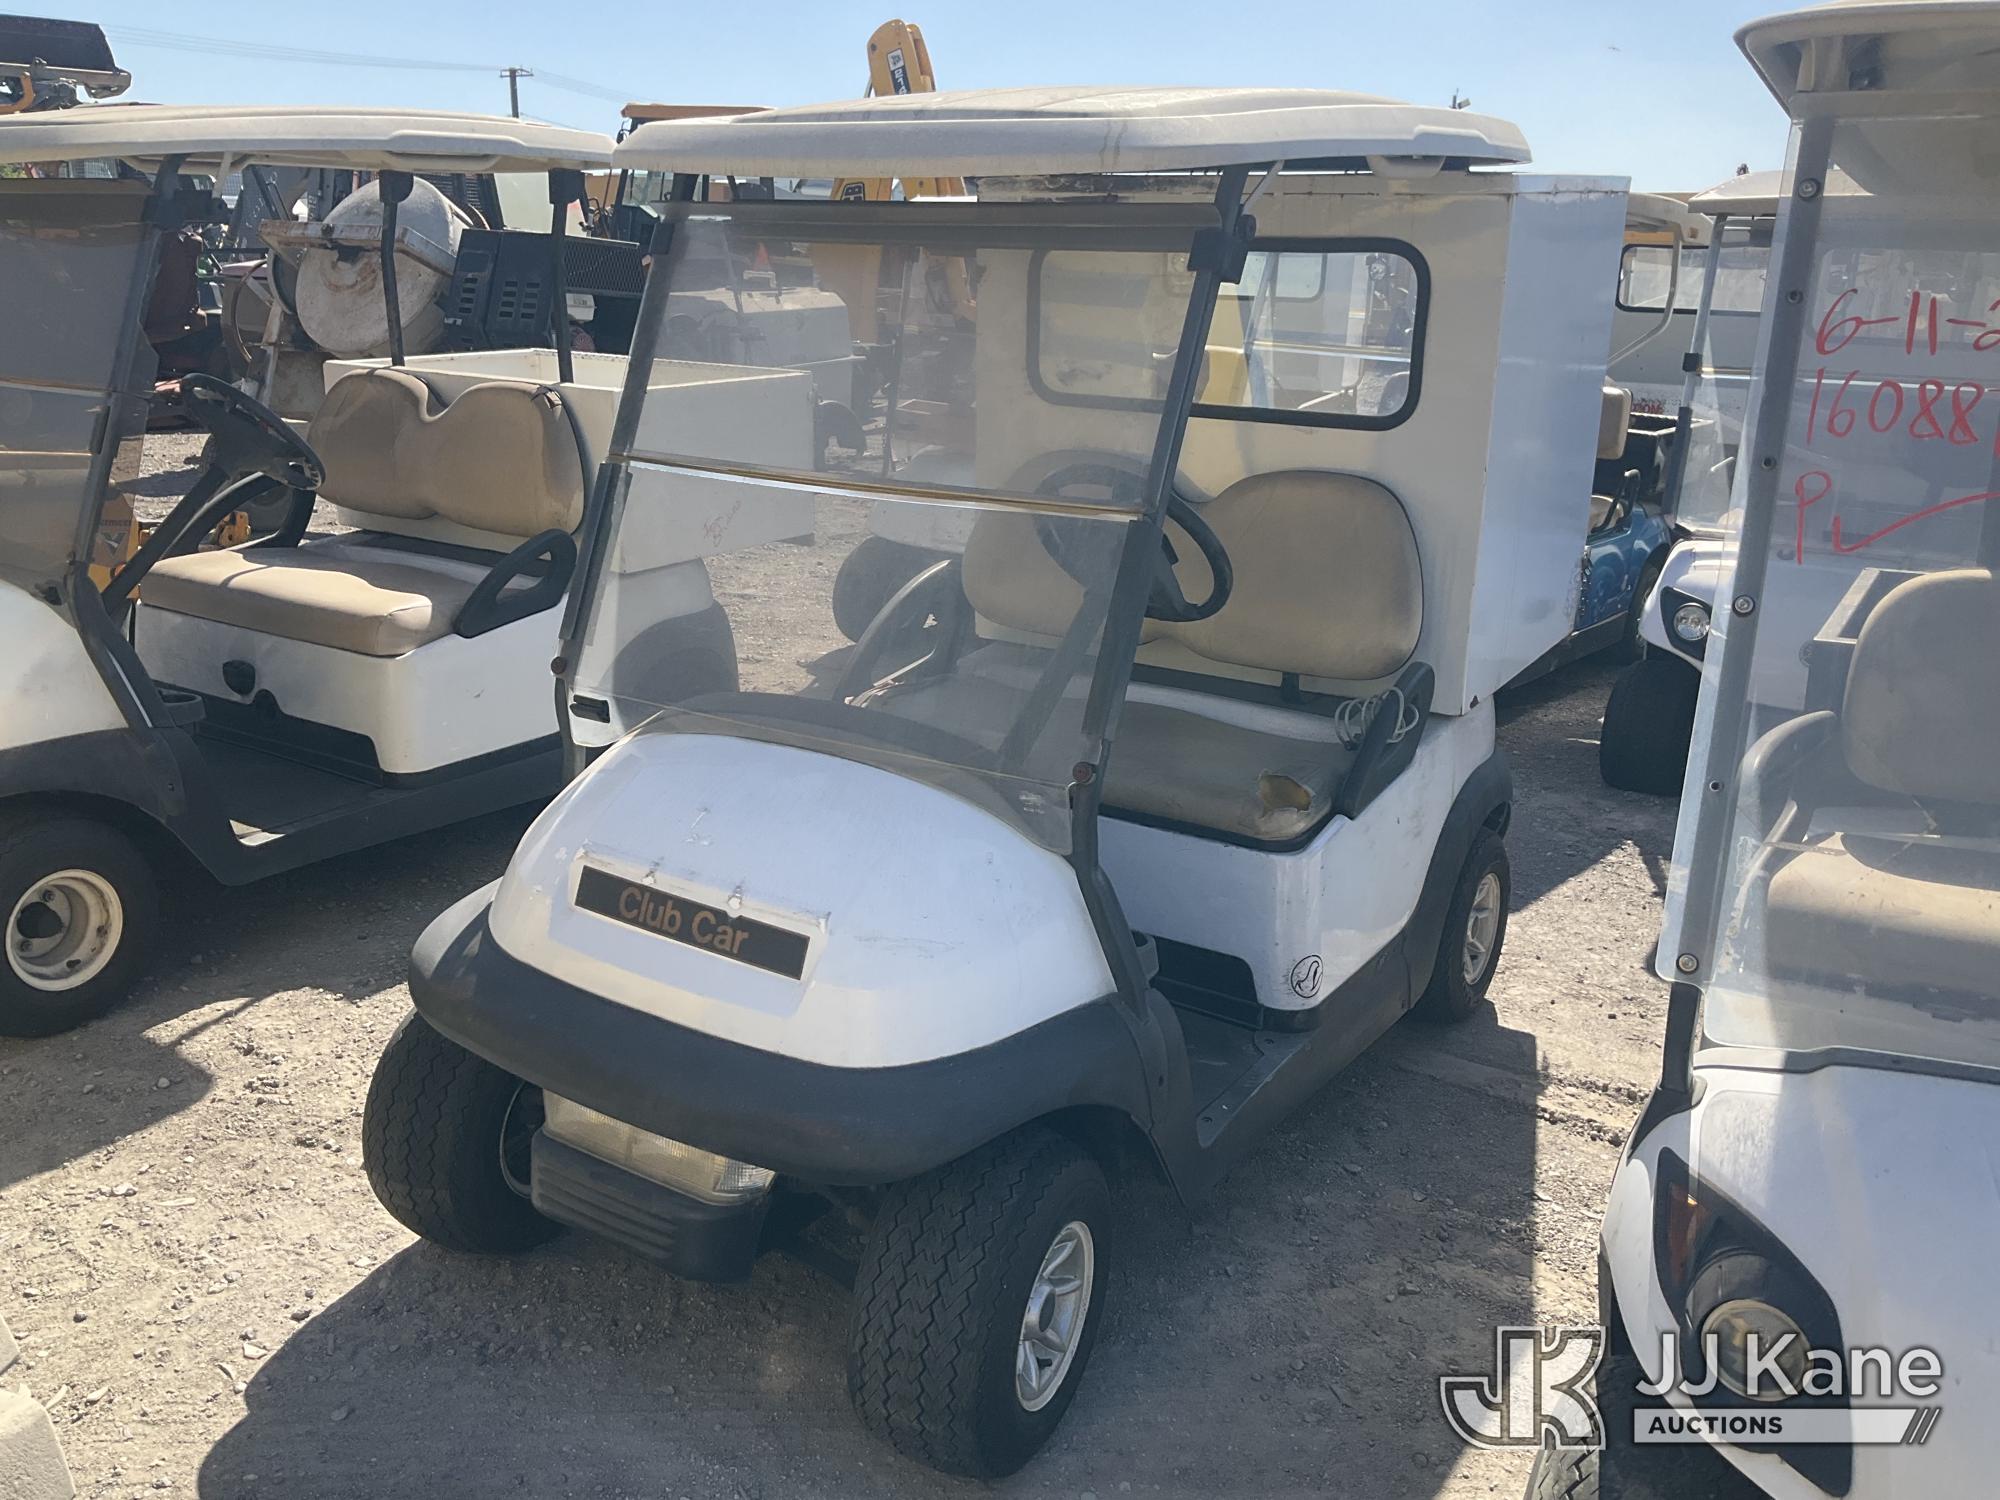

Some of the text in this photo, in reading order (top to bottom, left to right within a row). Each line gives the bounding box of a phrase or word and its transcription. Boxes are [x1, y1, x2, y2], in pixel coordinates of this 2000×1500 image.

[1807, 368, 2000, 459] 16088
[618, 886, 749, 954] Club Car
